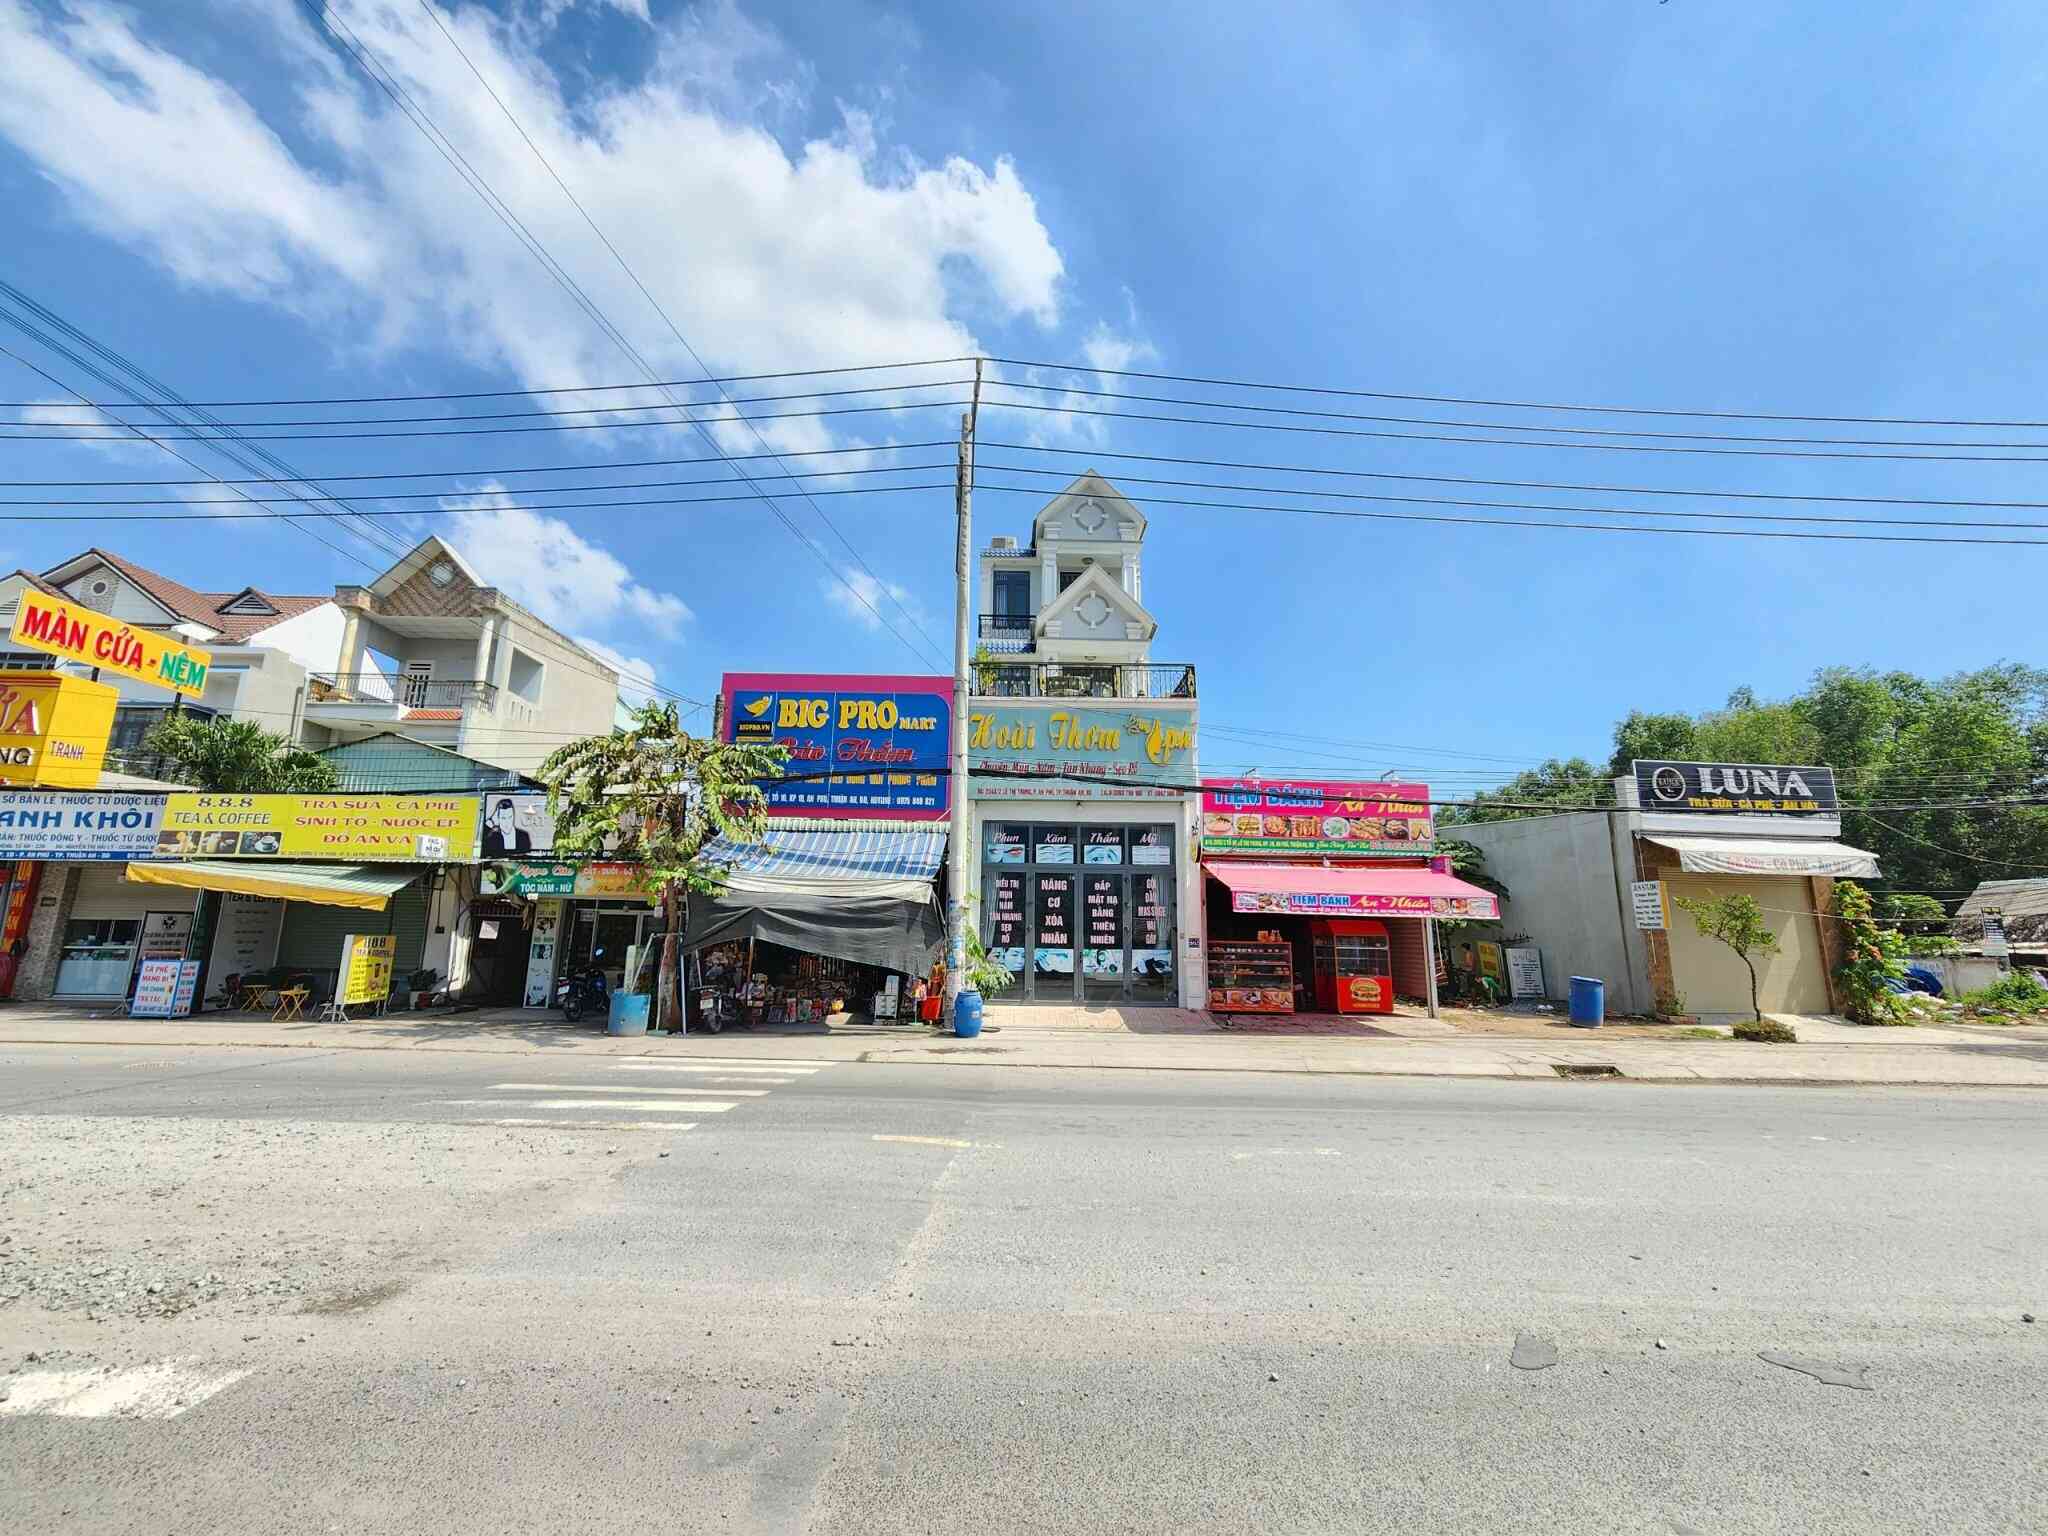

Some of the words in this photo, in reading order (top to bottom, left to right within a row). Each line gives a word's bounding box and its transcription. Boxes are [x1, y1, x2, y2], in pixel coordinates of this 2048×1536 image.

[22, 606, 88, 652] MÀN
[777, 699, 829, 729] BIG
[838, 699, 898, 729] PRO
[899, 717, 937, 730] MART
[49, 740, 86, 761] TRANH
[1697, 767, 1813, 797] LUNA
[174, 811, 200, 824] TEA
[204, 811, 213, 824] &
[218, 812, 271, 825] COFFEE
[295, 816, 337, 826] SINH
